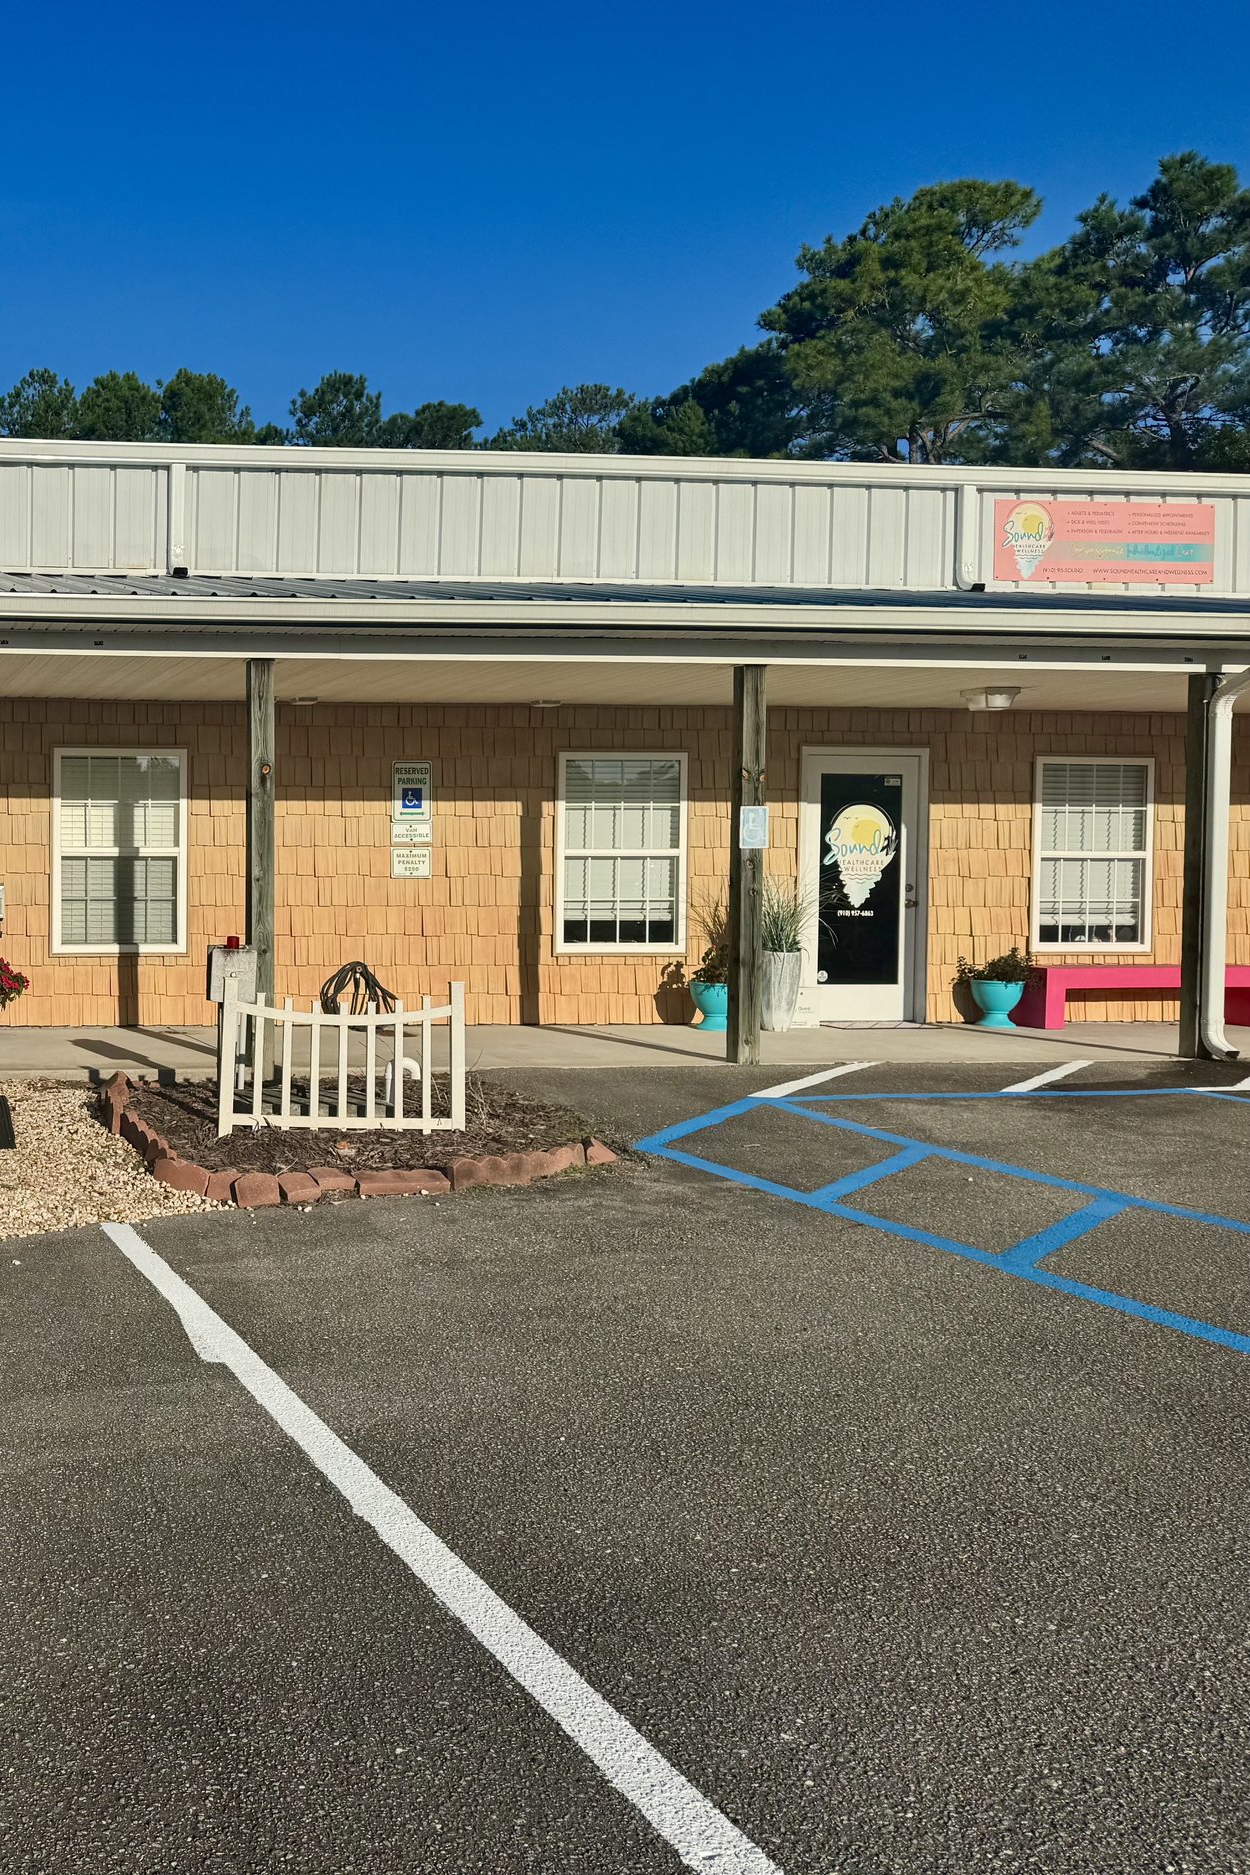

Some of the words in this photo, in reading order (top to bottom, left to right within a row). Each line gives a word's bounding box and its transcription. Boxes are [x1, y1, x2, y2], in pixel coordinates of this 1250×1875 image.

[1001, 520, 1044, 547] Sound
[395, 767, 429, 775] RESERVED
[397, 777, 427, 785] PARKING
[822, 828, 882, 865] Sound
[837, 909, 850, 917] (910)
